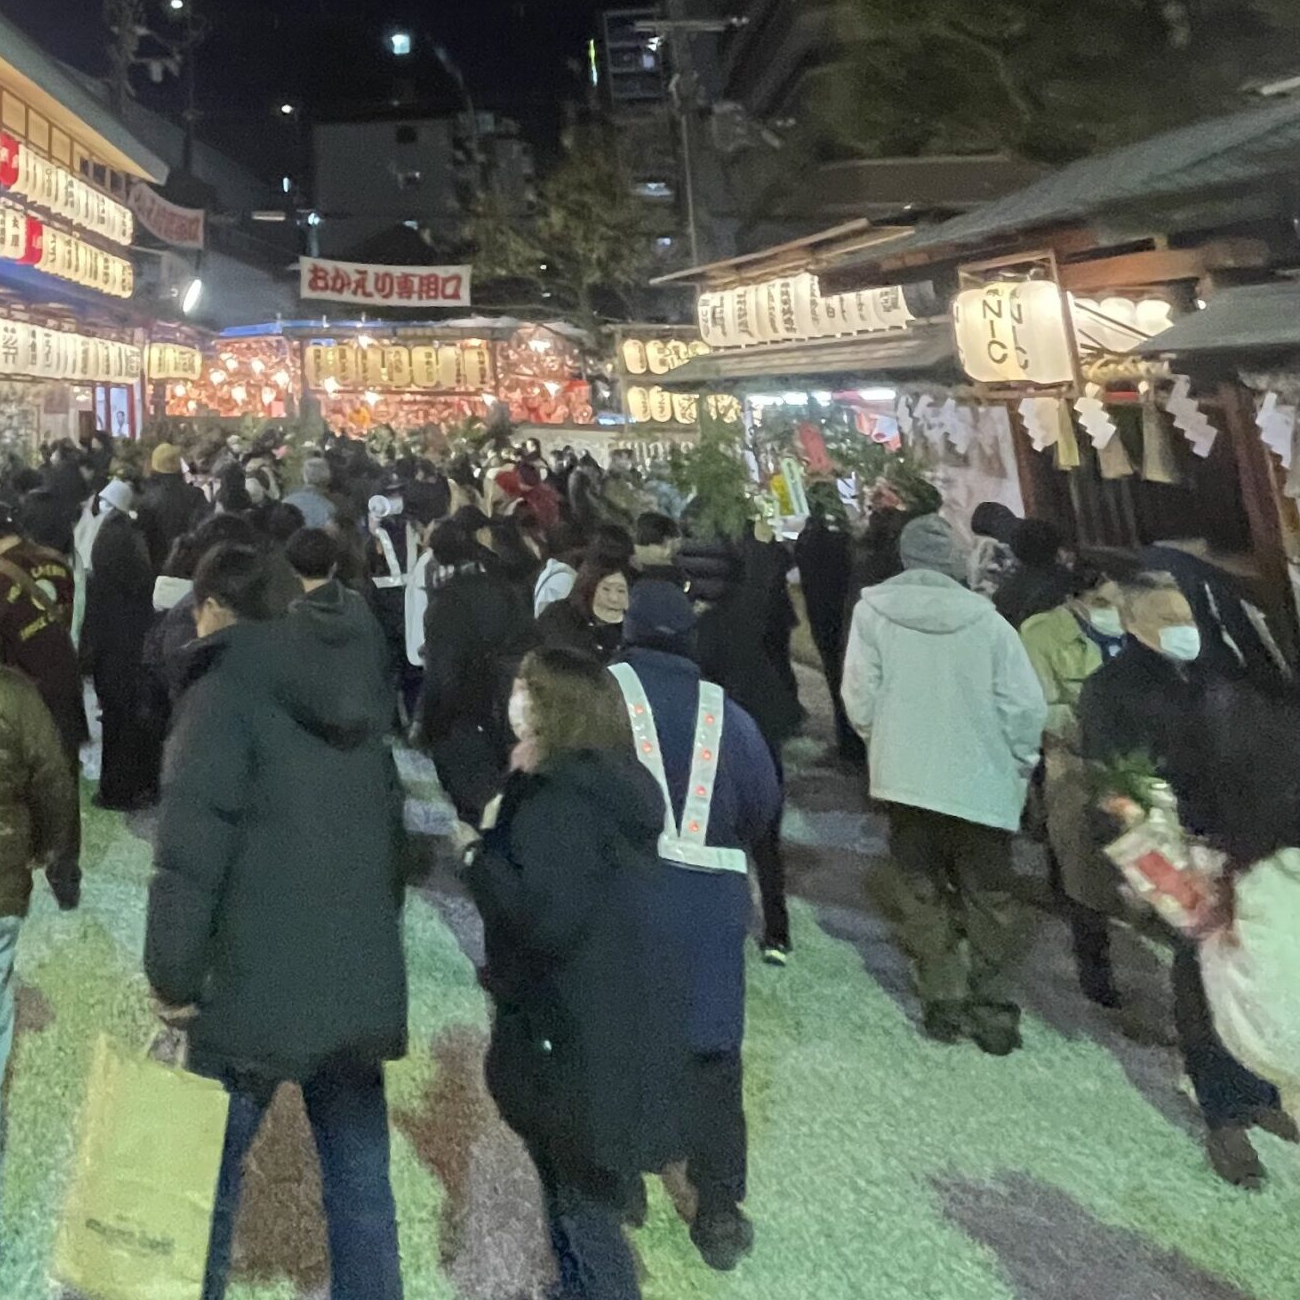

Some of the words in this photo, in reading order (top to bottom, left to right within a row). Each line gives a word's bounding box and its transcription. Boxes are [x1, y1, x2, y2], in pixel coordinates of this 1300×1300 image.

[308, 265, 462, 300] おかえり専用口
